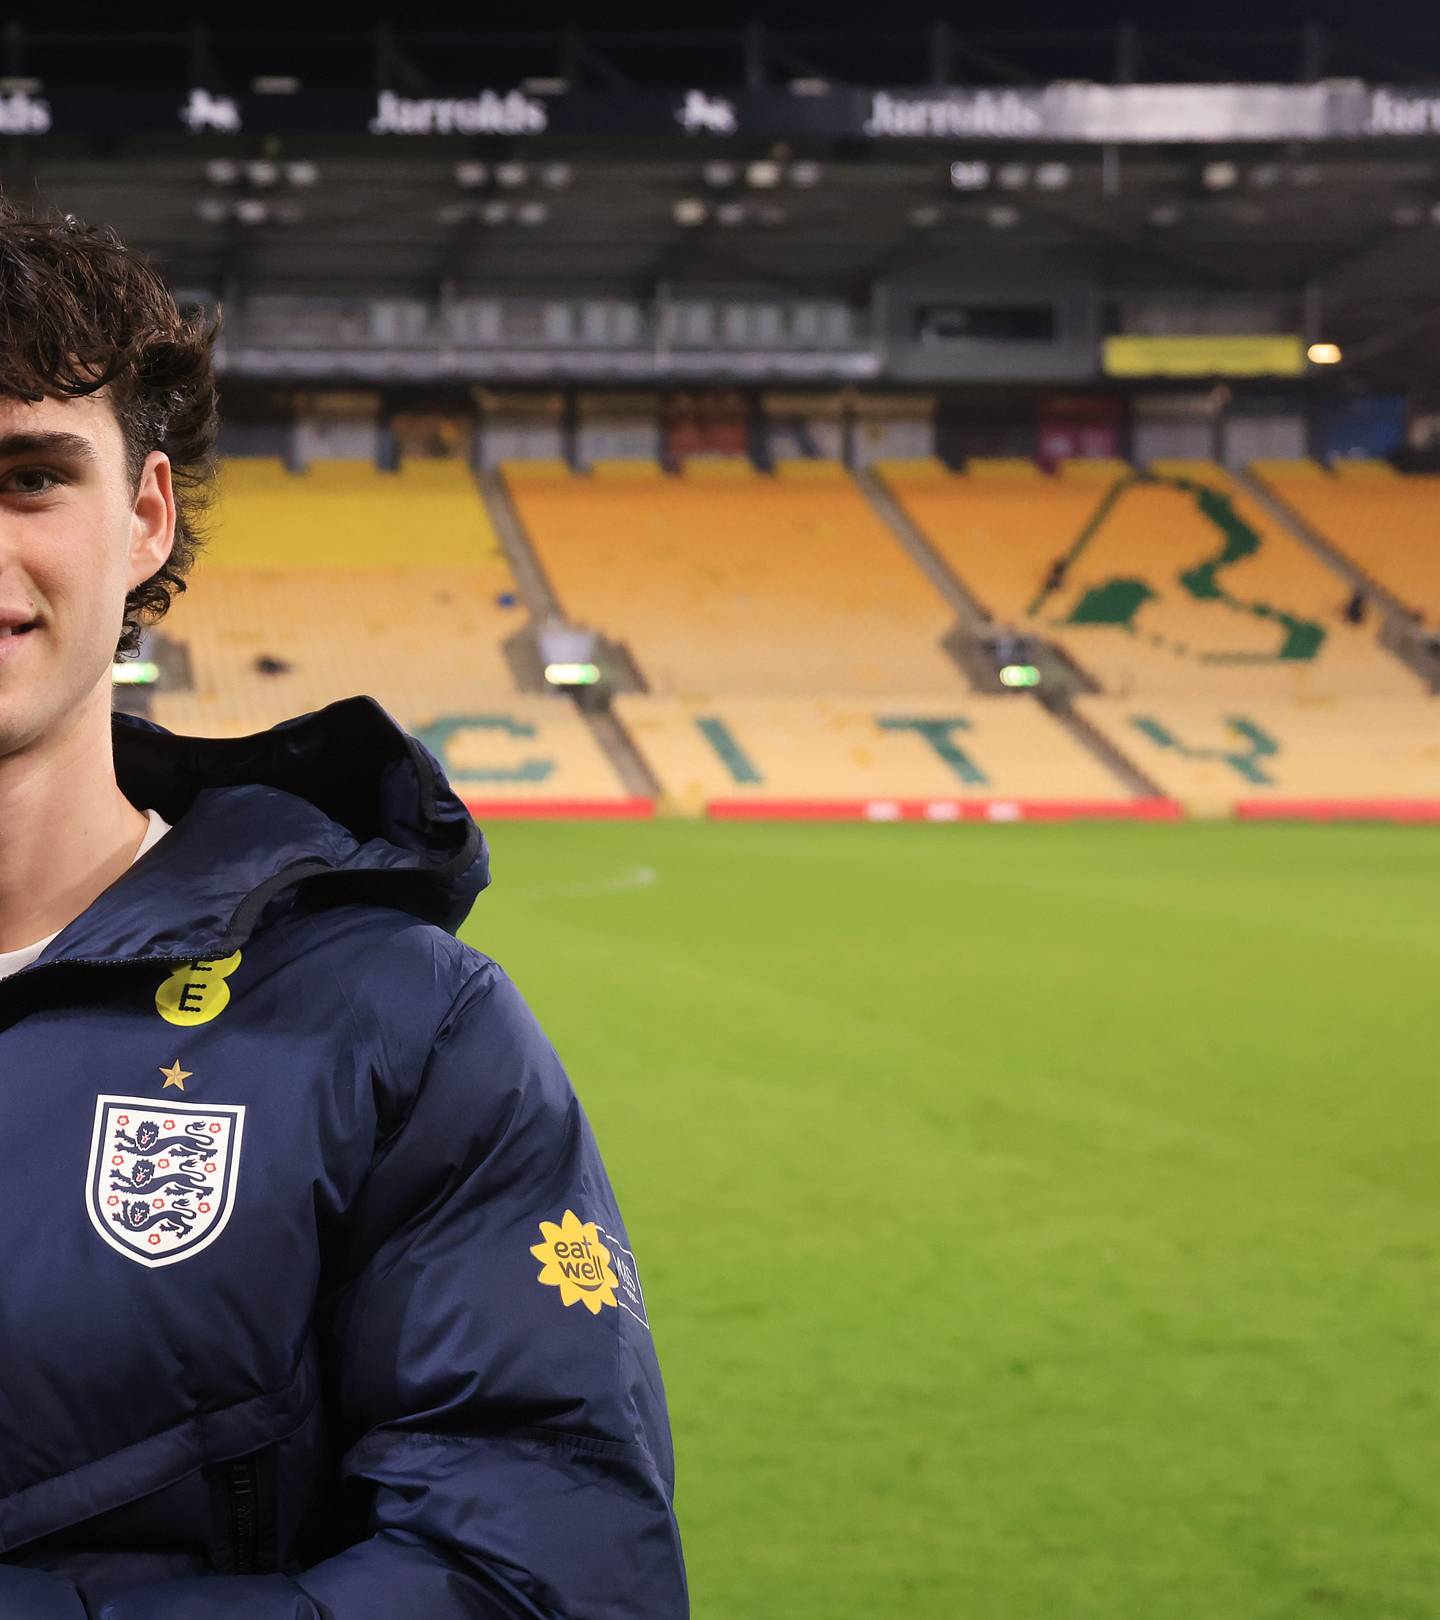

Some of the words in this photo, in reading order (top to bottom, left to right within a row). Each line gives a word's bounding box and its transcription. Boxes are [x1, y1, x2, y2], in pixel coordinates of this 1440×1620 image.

[370, 88, 548, 135] Jarrolds
[553, 1234, 592, 1260] eat
[558, 1255, 605, 1281] well
